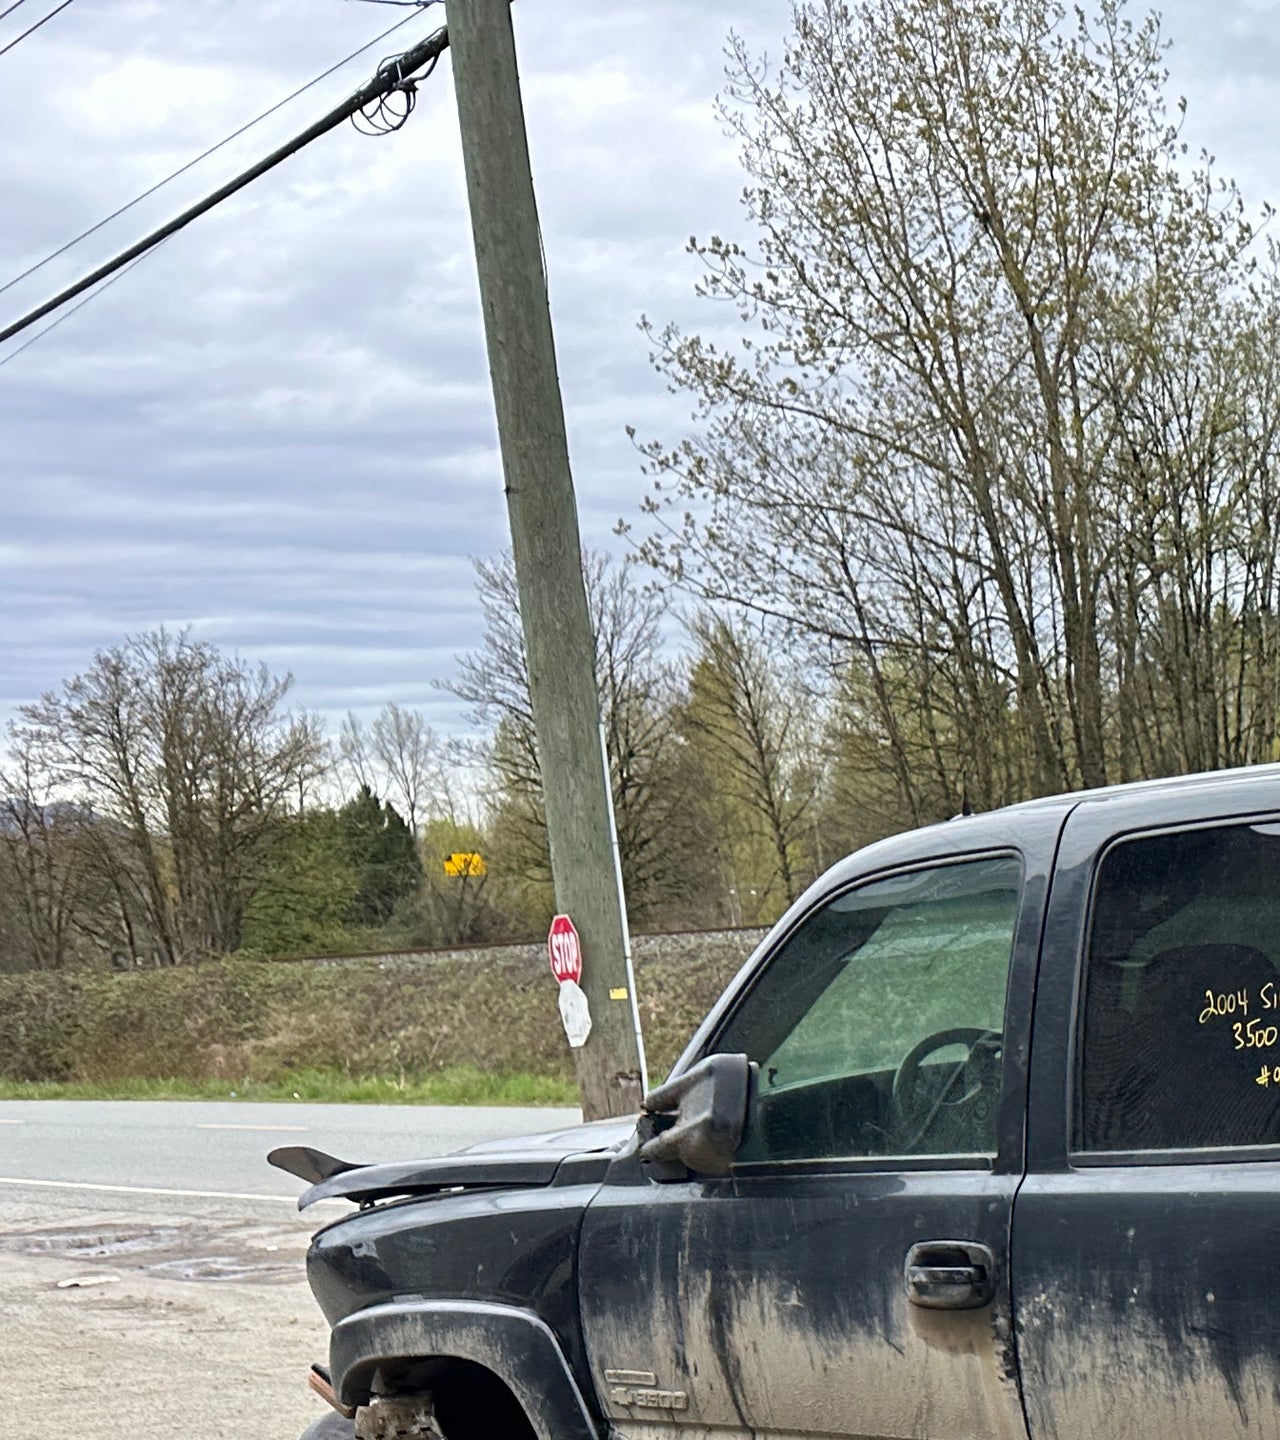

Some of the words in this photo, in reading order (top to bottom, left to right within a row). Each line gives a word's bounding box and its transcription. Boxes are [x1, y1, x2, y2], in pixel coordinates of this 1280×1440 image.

[551, 931, 579, 975] STOP
[1198, 988, 1249, 1024] 2004
[1231, 1017, 1279, 1050] 3500
